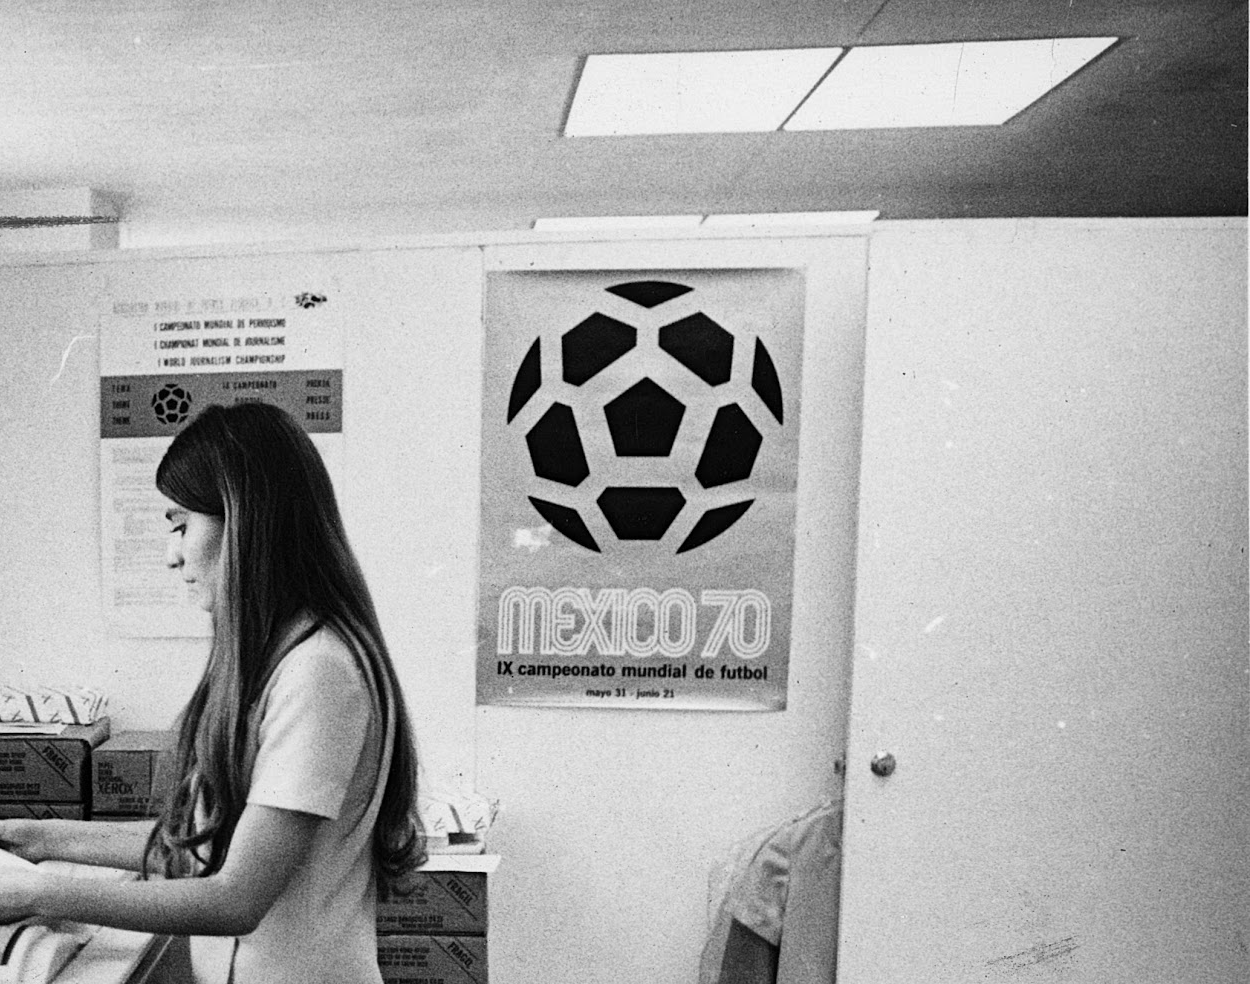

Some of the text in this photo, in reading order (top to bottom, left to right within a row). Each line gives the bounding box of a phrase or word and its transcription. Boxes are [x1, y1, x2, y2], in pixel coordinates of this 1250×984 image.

[497, 586, 772, 659] MEXICO 70
[497, 661, 768, 680] IX campeonato mundial de futbol
[586, 689, 612, 698] mayo
[615, 688, 626, 698] 31
[636, 688, 660, 699] junio
[663, 689, 674, 698] 21
[98, 782, 133, 795] XEROX
[446, 878, 475, 906] FRAGIL
